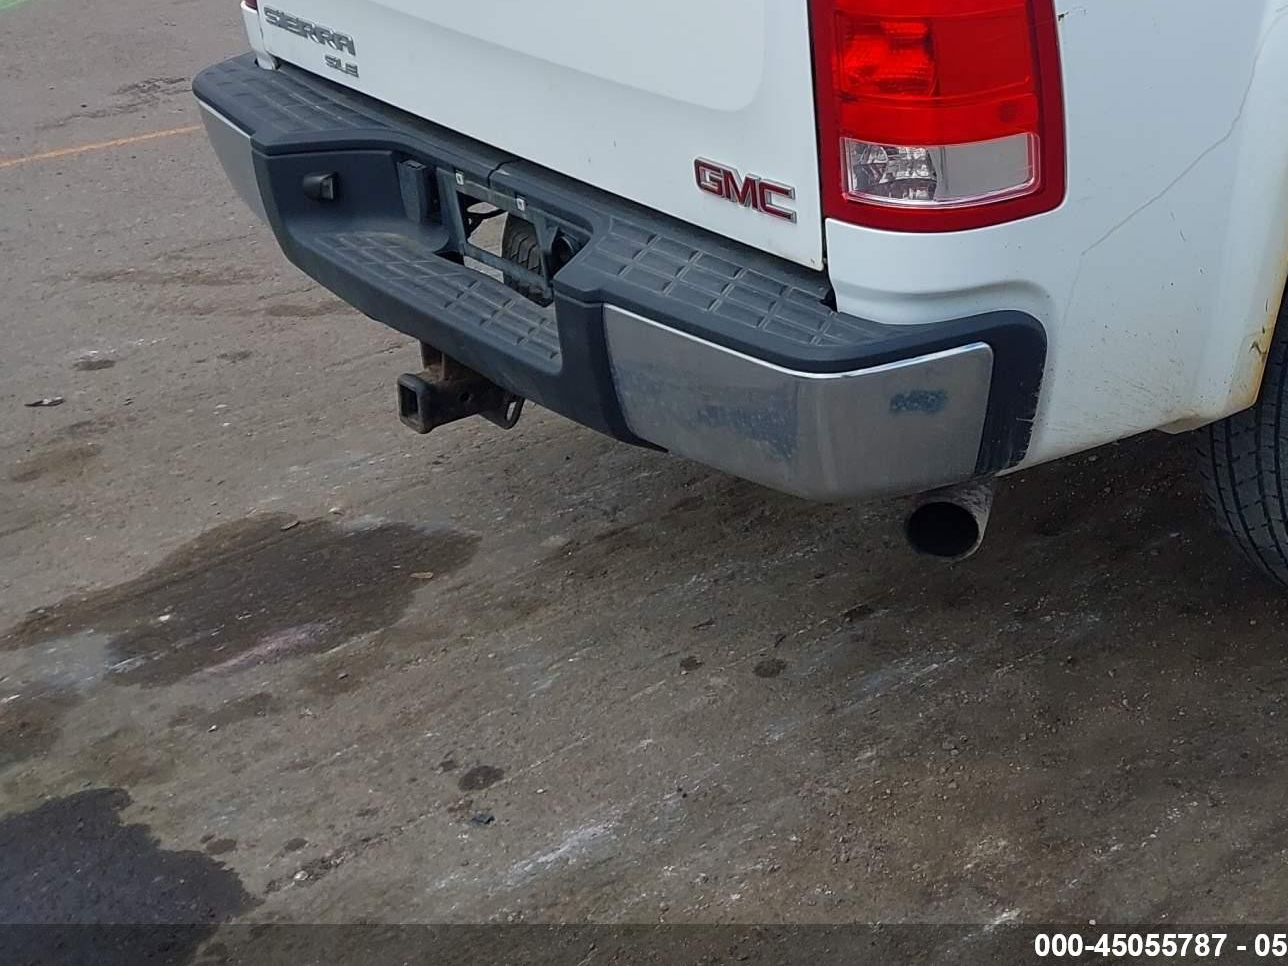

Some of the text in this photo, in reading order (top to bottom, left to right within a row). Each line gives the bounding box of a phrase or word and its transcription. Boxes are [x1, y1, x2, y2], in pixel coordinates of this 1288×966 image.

[263, 6, 356, 56] SIERRA
[324, 54, 359, 78] SLE
[694, 156, 798, 224] GMC
